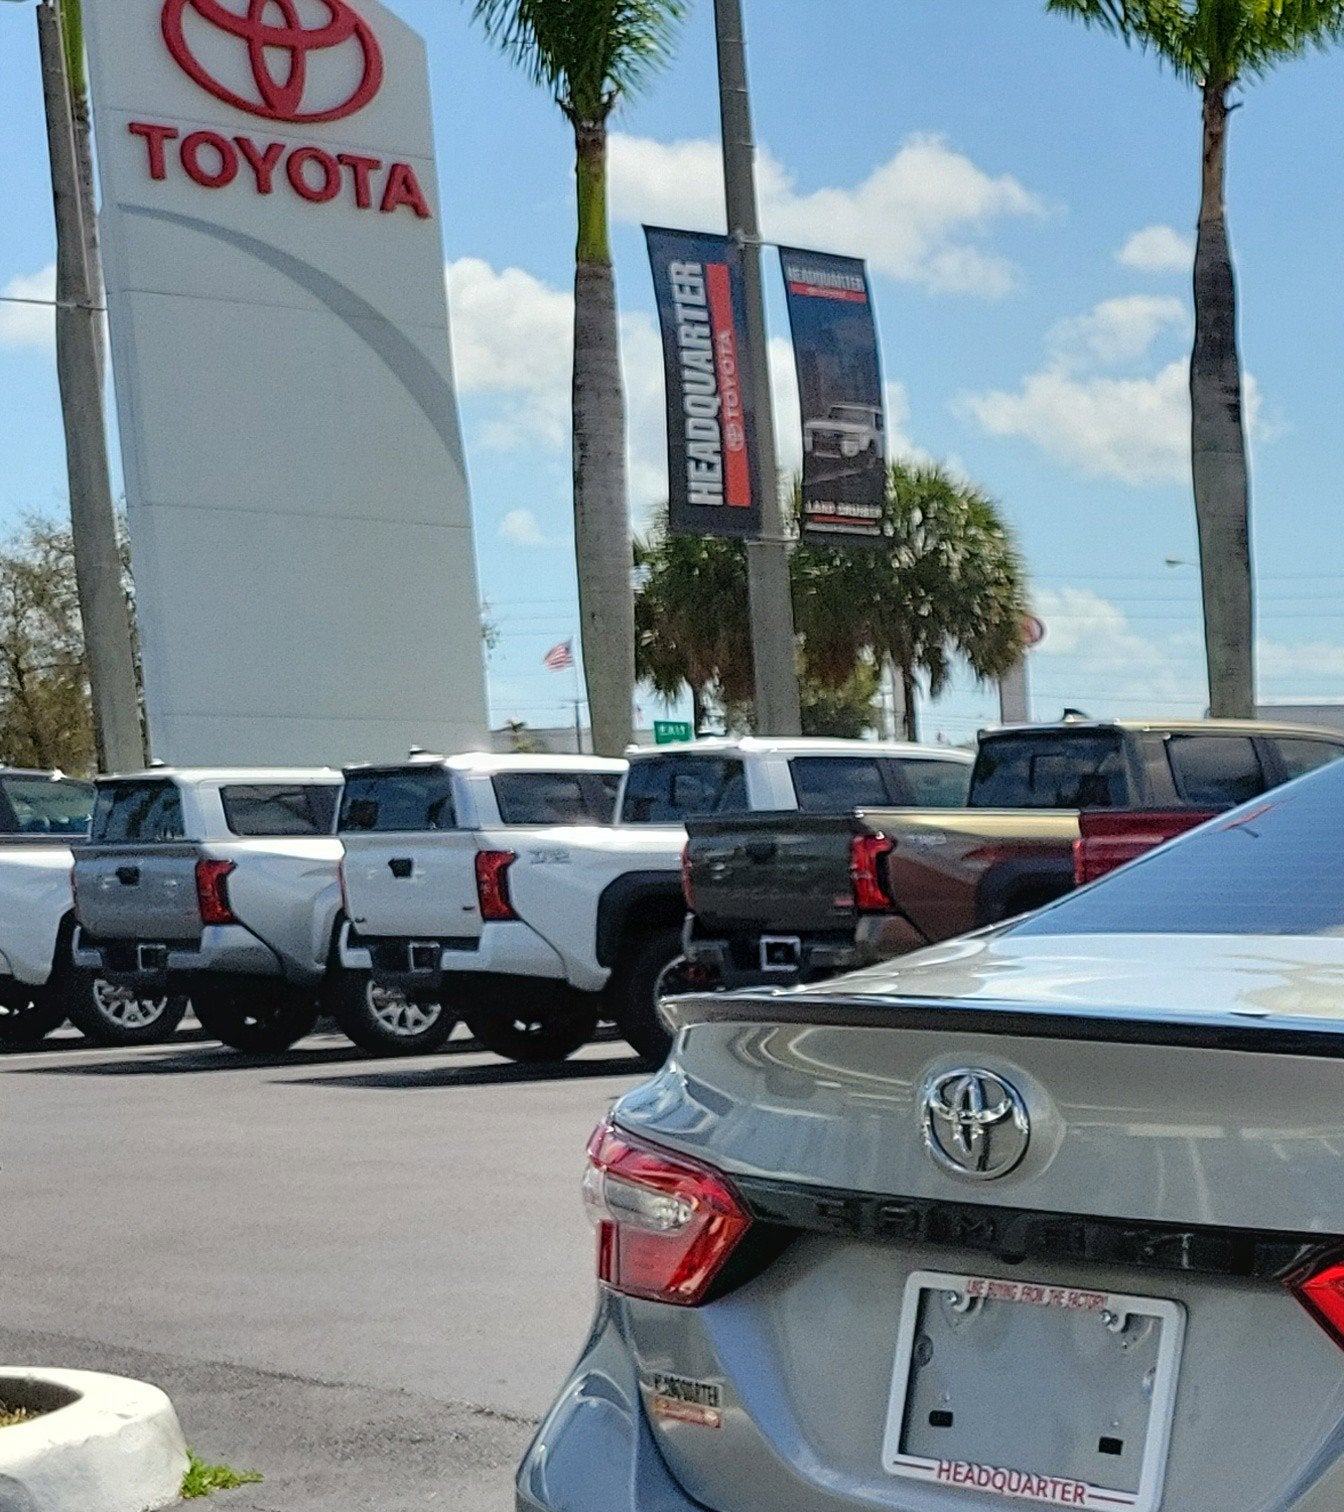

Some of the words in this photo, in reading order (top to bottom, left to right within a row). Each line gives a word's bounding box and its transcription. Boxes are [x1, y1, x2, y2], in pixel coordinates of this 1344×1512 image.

[128, 121, 432, 219] TOYOTA
[669, 260, 723, 505] HEADQUARTER
[717, 329, 742, 419] TOYOTA
[937, 1460, 1086, 1505] HEADQUARTER
